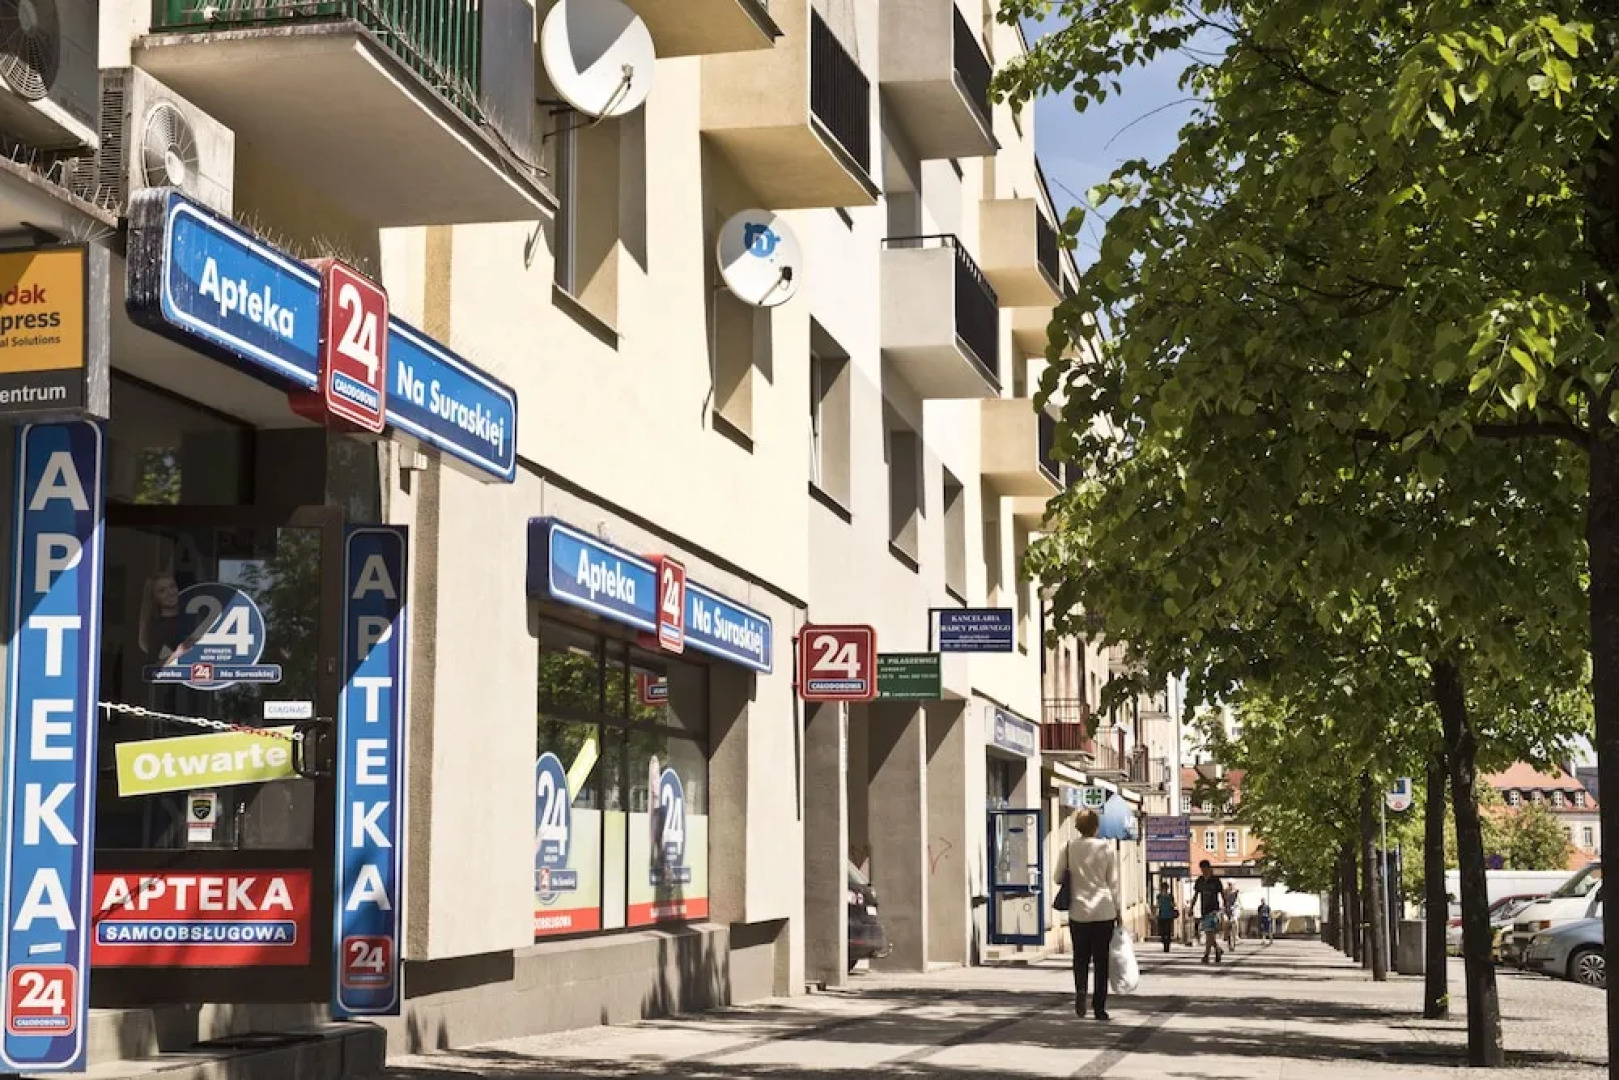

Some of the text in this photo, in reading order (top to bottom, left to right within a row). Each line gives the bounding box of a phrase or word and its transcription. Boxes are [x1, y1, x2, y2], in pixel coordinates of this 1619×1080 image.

[0, 284, 46, 306] dak
[12, 335, 61, 347] Solutions
[199, 258, 505, 458] Apteka 24 Na Suraskiej
[185, 595, 255, 656] 24
[576, 549, 765, 664] Apteka 24 Na Suraskiej
[951, 614, 1001, 623] KANCELARIA
[968, 624, 1011, 632] PRAWNEGO
[194, 665, 210, 679] 24
[219, 670, 234, 678] Na
[811, 634, 862, 679] 24
[12, 450, 91, 931] APTEKA
[345, 554, 398, 911] APTEKA
[132, 744, 288, 782] Otwarte
[537, 770, 568, 856] 24
[661, 783, 684, 856] 24
[100, 877, 294, 911] APTEKA
[106, 925, 287, 942] SAMOOBSŁUGOWA
[350, 940, 386, 973] 24
[17, 970, 66, 1015] 24
